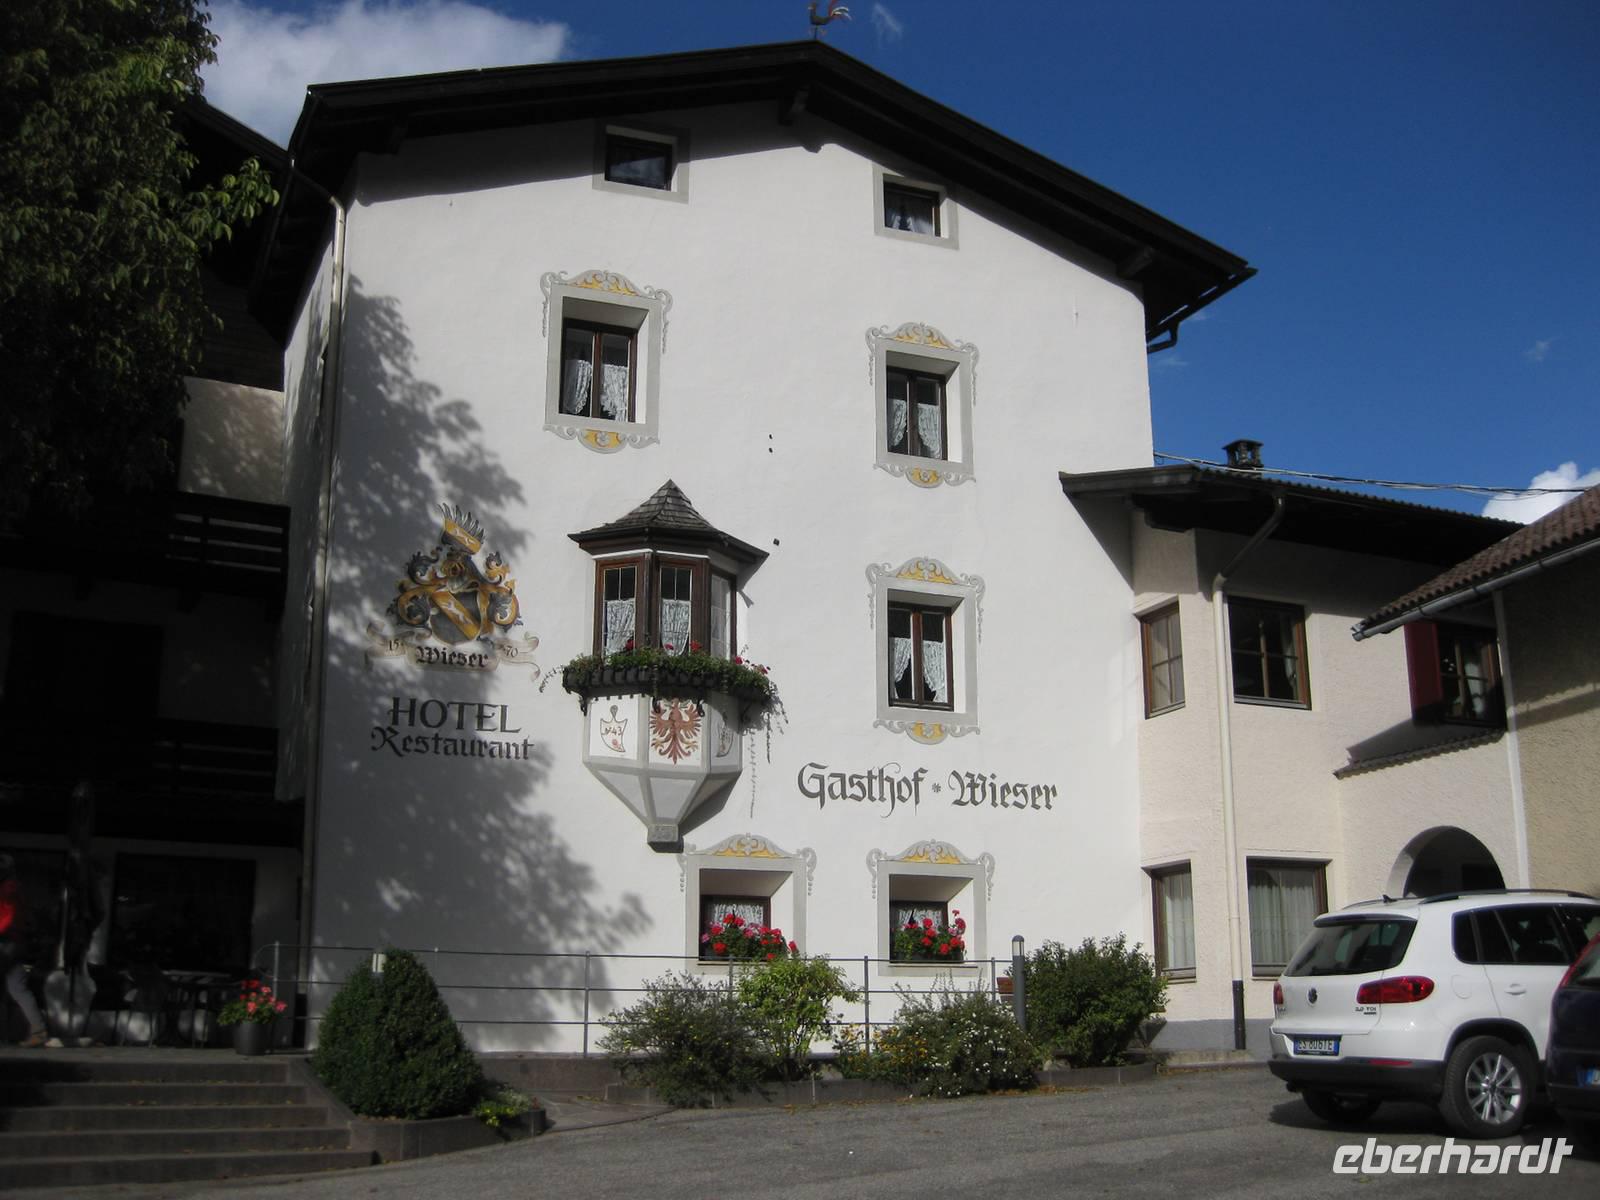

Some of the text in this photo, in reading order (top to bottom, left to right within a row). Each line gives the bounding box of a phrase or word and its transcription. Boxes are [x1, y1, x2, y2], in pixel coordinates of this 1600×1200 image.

[415, 646, 489, 668] Wieser
[387, 697, 522, 733] HOTEL
[371, 726, 535, 761] Restaurant
[797, 762, 1058, 818] Gasthof Wieser
